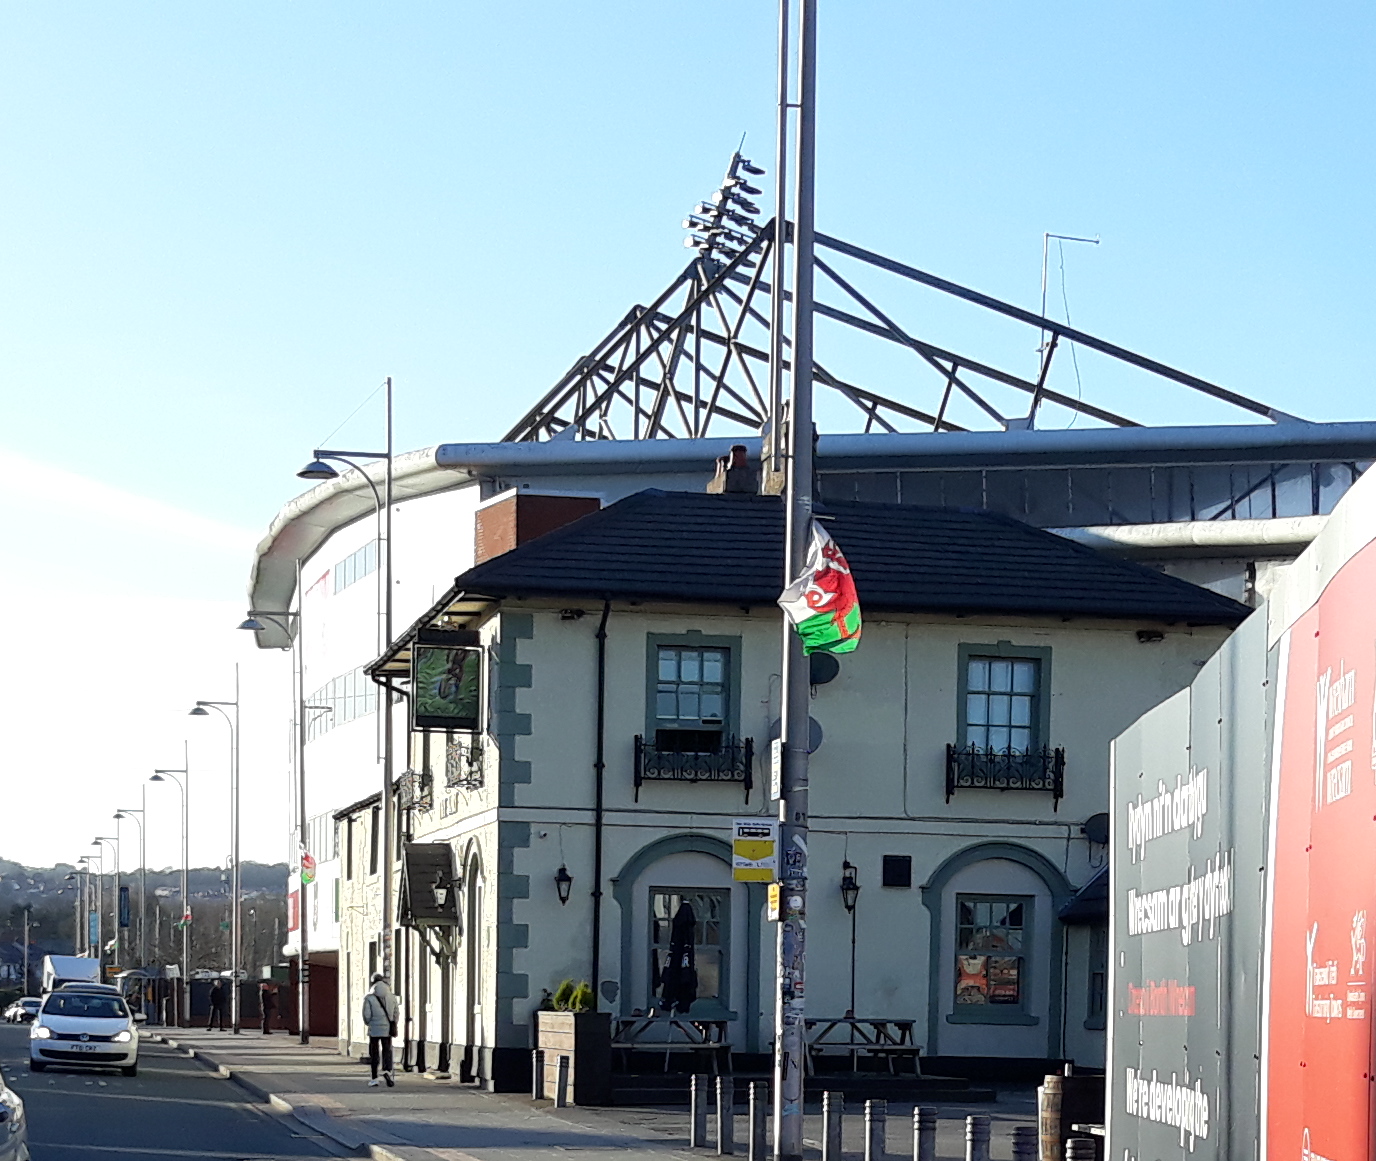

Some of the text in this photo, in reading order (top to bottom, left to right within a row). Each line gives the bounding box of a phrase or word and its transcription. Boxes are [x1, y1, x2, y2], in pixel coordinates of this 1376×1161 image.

[1128, 889, 1168, 936] Wrecsam
[1169, 887, 1181, 930] ar
[1126, 1067, 1209, 1153] We're developing the
